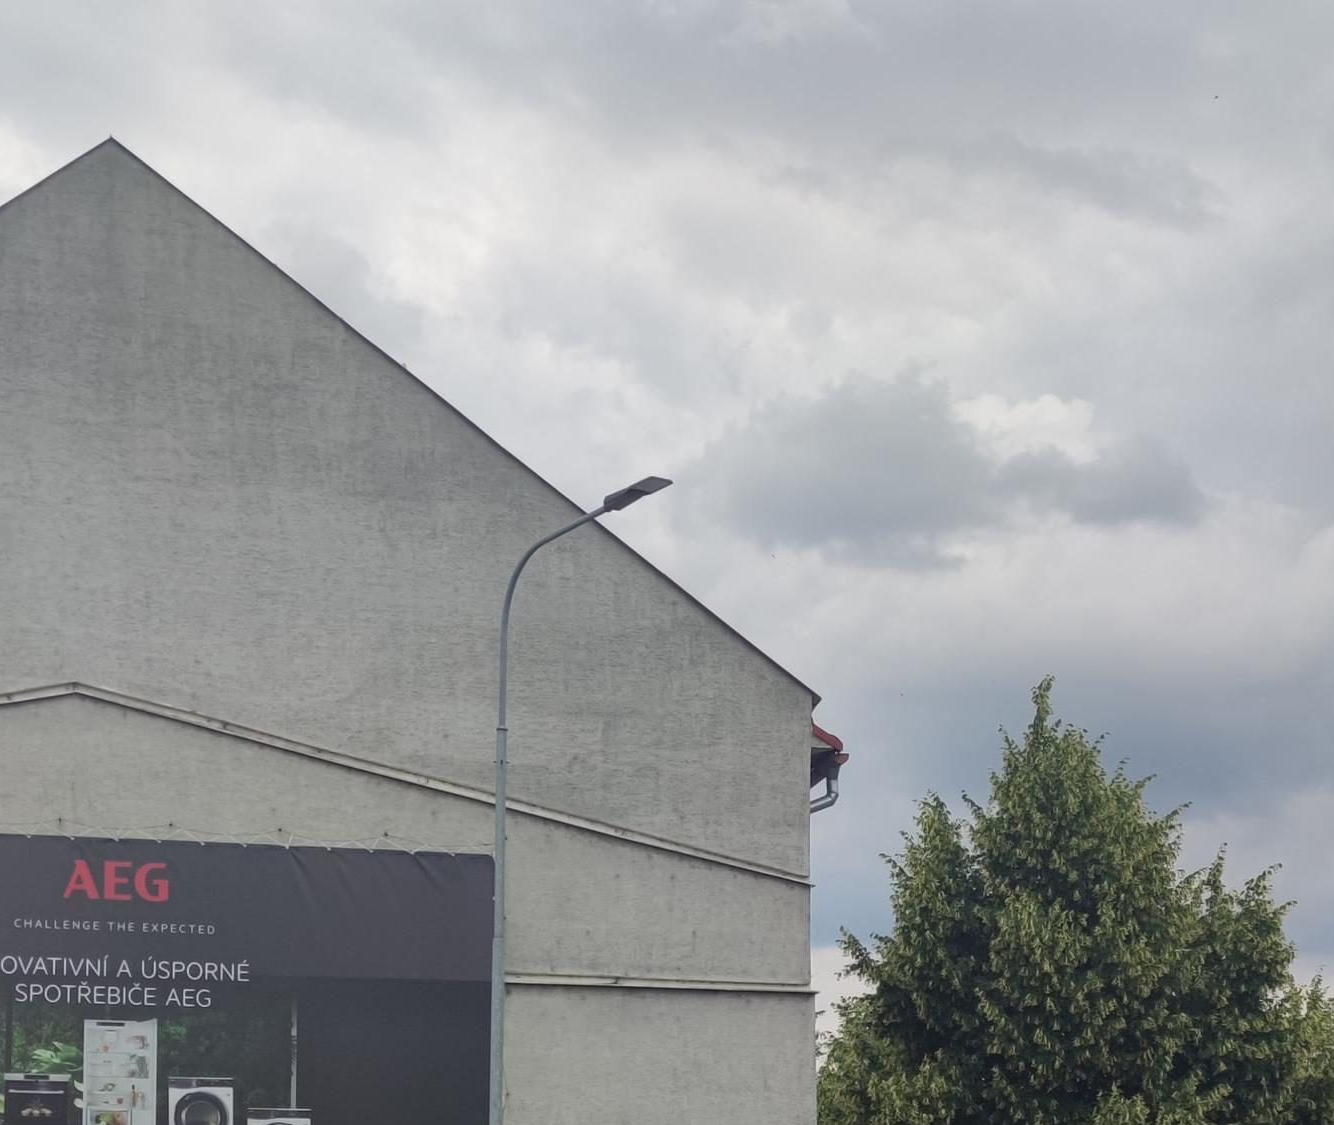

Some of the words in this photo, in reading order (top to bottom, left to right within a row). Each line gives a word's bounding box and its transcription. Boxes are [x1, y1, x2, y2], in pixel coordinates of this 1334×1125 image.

[63, 859, 169, 902] AEG
[13, 918, 100, 931] CHALLENGE
[107, 921, 135, 932] THE
[142, 922, 216, 935] EXPECTED
[116, 959, 132, 978] A
[141, 955, 250, 982] ÚSPORNÉ
[15, 980, 157, 1006] SPOTŘEBIČE
[165, 988, 212, 1008] AEG
